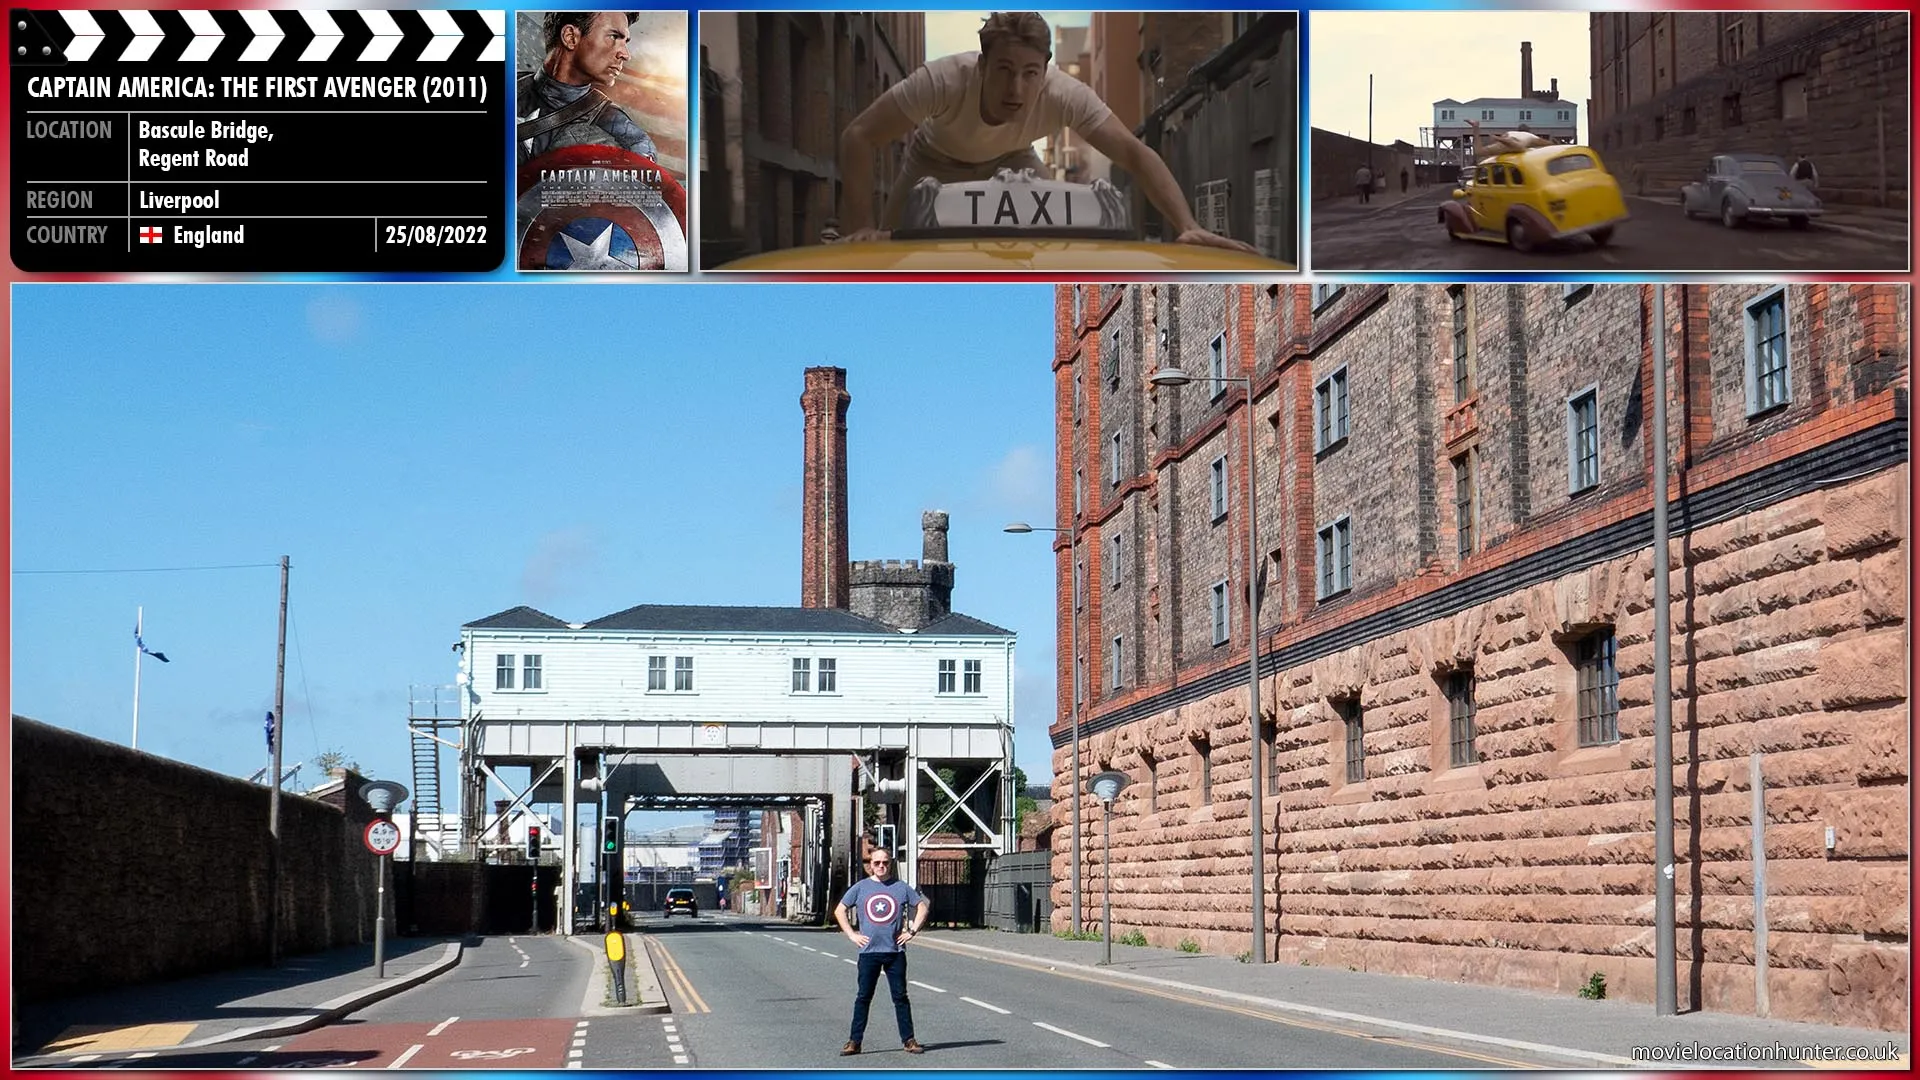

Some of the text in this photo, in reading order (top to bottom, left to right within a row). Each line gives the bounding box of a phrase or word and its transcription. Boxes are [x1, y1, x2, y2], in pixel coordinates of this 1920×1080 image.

[541, 169, 663, 184] CAPTAIN AMERICA
[964, 190, 1072, 225] TAXI
